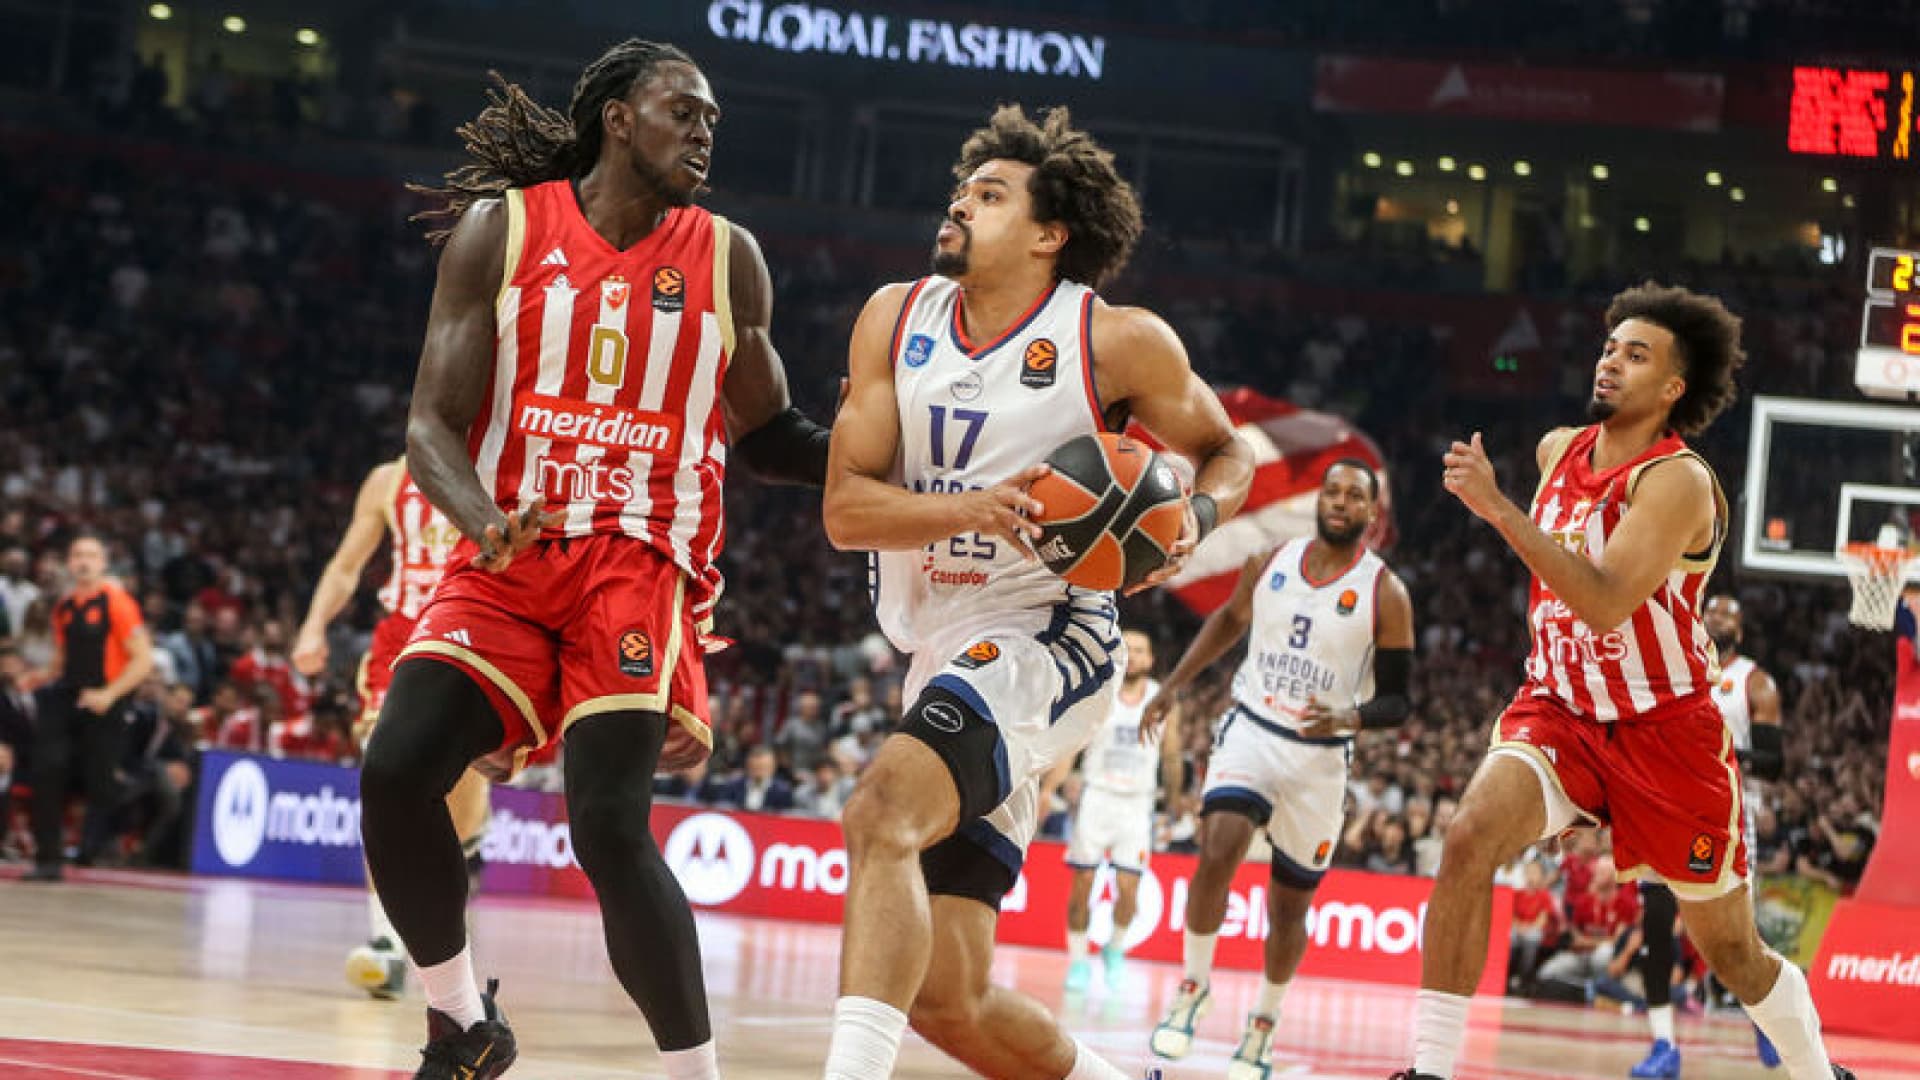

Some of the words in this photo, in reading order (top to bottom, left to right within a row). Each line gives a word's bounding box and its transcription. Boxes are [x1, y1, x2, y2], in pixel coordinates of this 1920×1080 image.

[907, 19, 1104, 79] FASHION
[588, 327, 627, 388] 0
[518, 404, 671, 451] meridian
[929, 405, 989, 471] 17
[535, 455, 634, 501] mts
[1288, 613, 1313, 649] 3
[1552, 630, 1628, 662] mts
